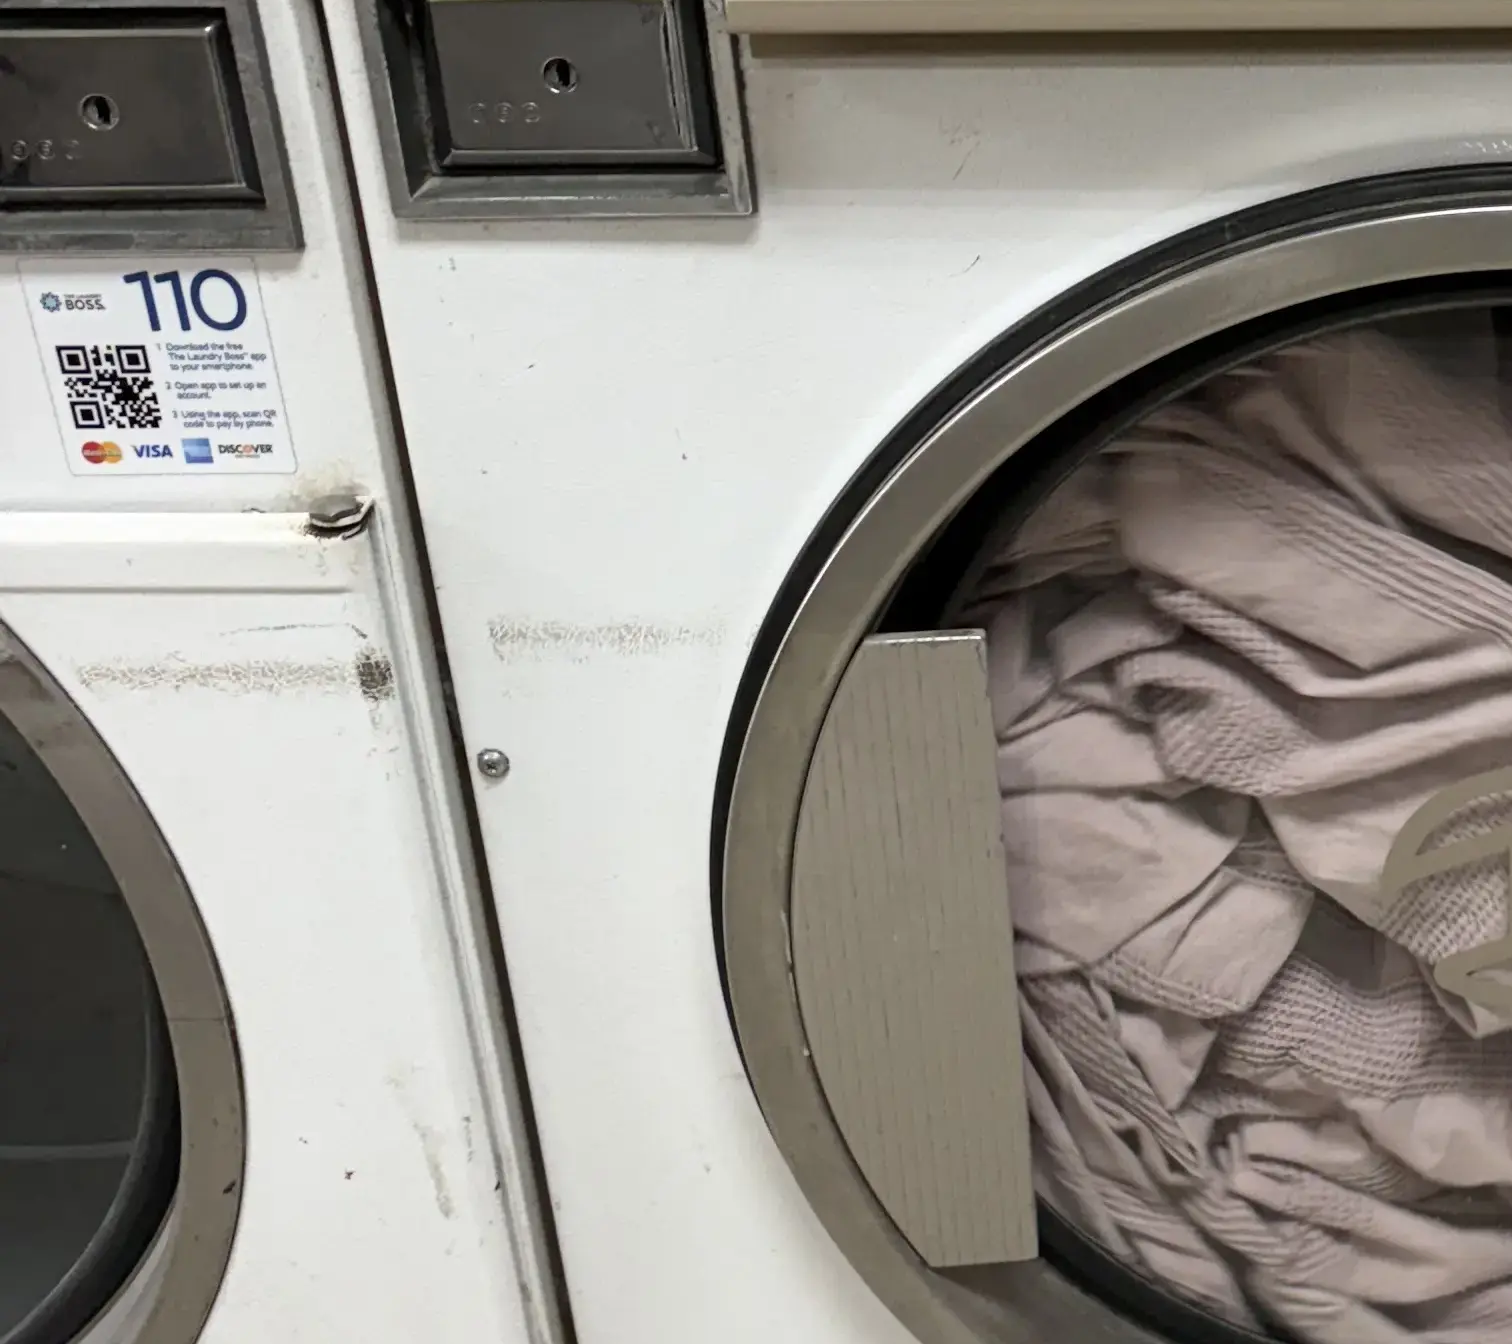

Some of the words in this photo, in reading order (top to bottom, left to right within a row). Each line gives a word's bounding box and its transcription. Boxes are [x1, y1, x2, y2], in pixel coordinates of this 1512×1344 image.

[123, 269, 248, 332] 110
[133, 444, 174, 458] VISA
[218, 444, 273, 455] DISCOVER
